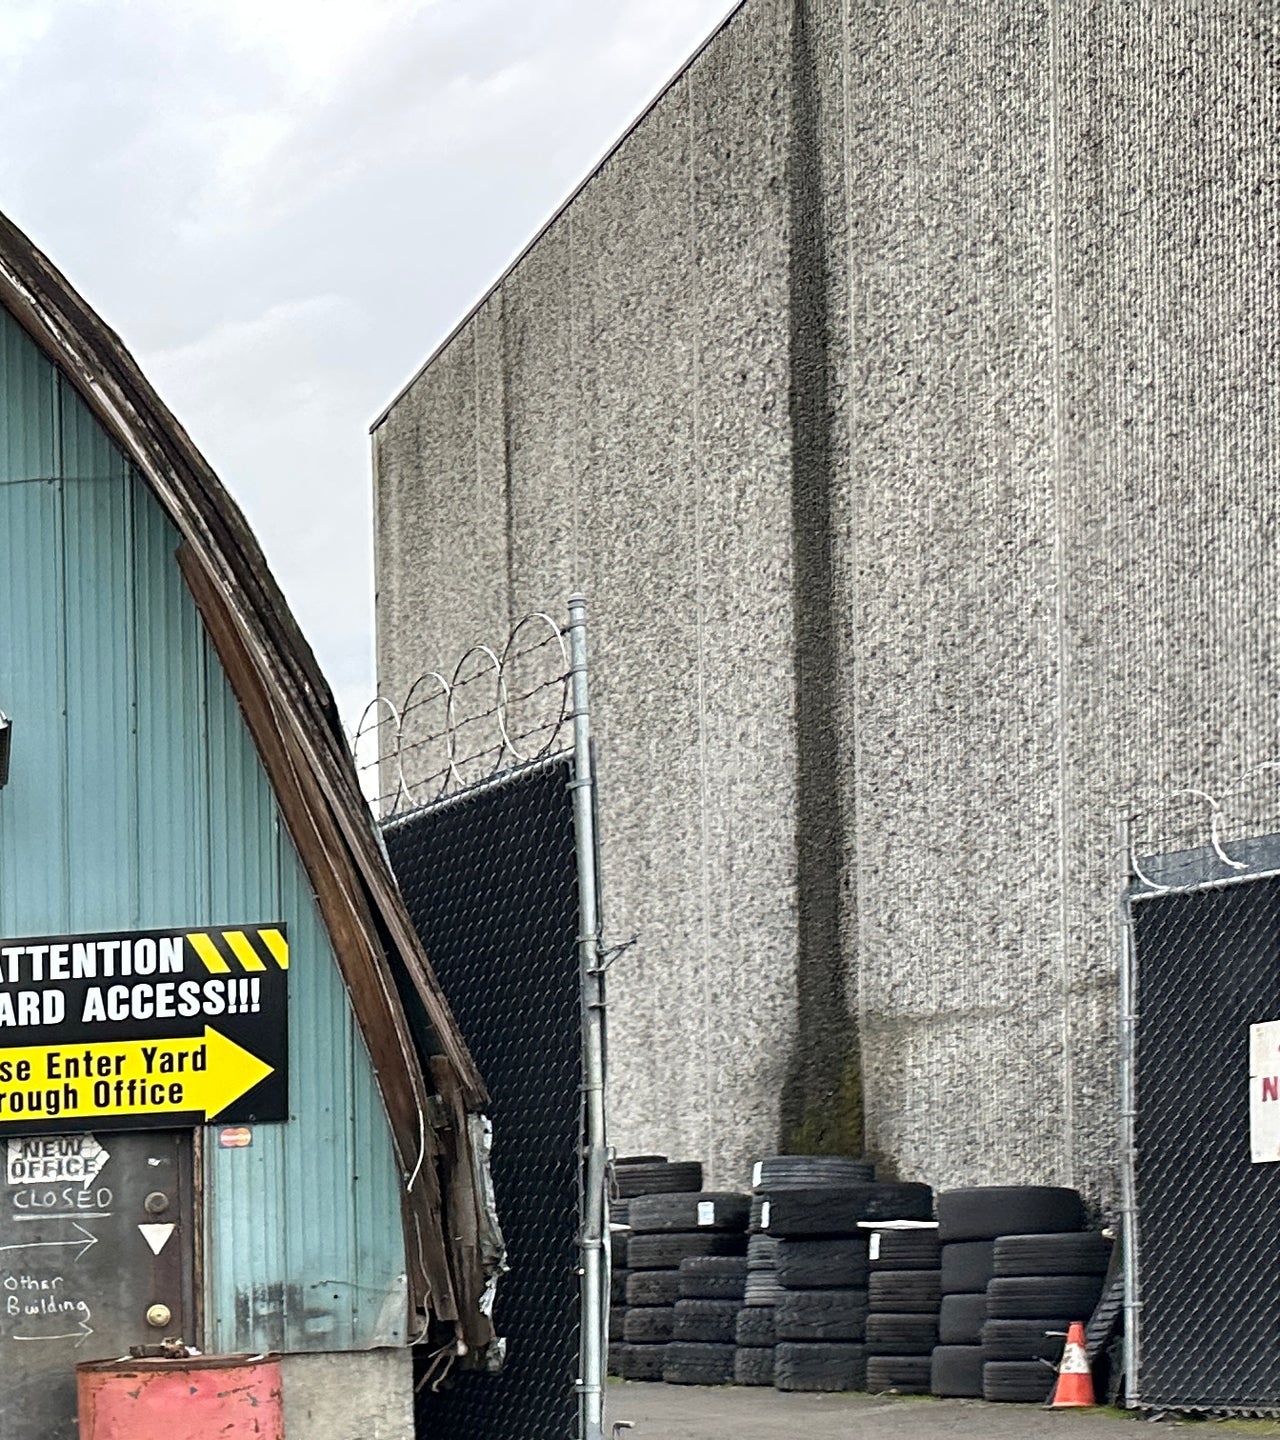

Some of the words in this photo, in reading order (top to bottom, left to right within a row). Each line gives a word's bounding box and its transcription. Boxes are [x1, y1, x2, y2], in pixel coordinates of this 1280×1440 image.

[81, 978, 261, 1023] ACCESS!!!
[46, 1052, 127, 1081] Enter
[140, 1044, 207, 1075] Yard
[93, 1079, 184, 1107] Office
[24, 1139, 81, 1157] NEW
[11, 1158, 97, 1178] OFFICE
[13, 1188, 113, 1208] CLOSED
[3, 1275, 64, 1291] Other
[6, 1296, 91, 1321] Building
